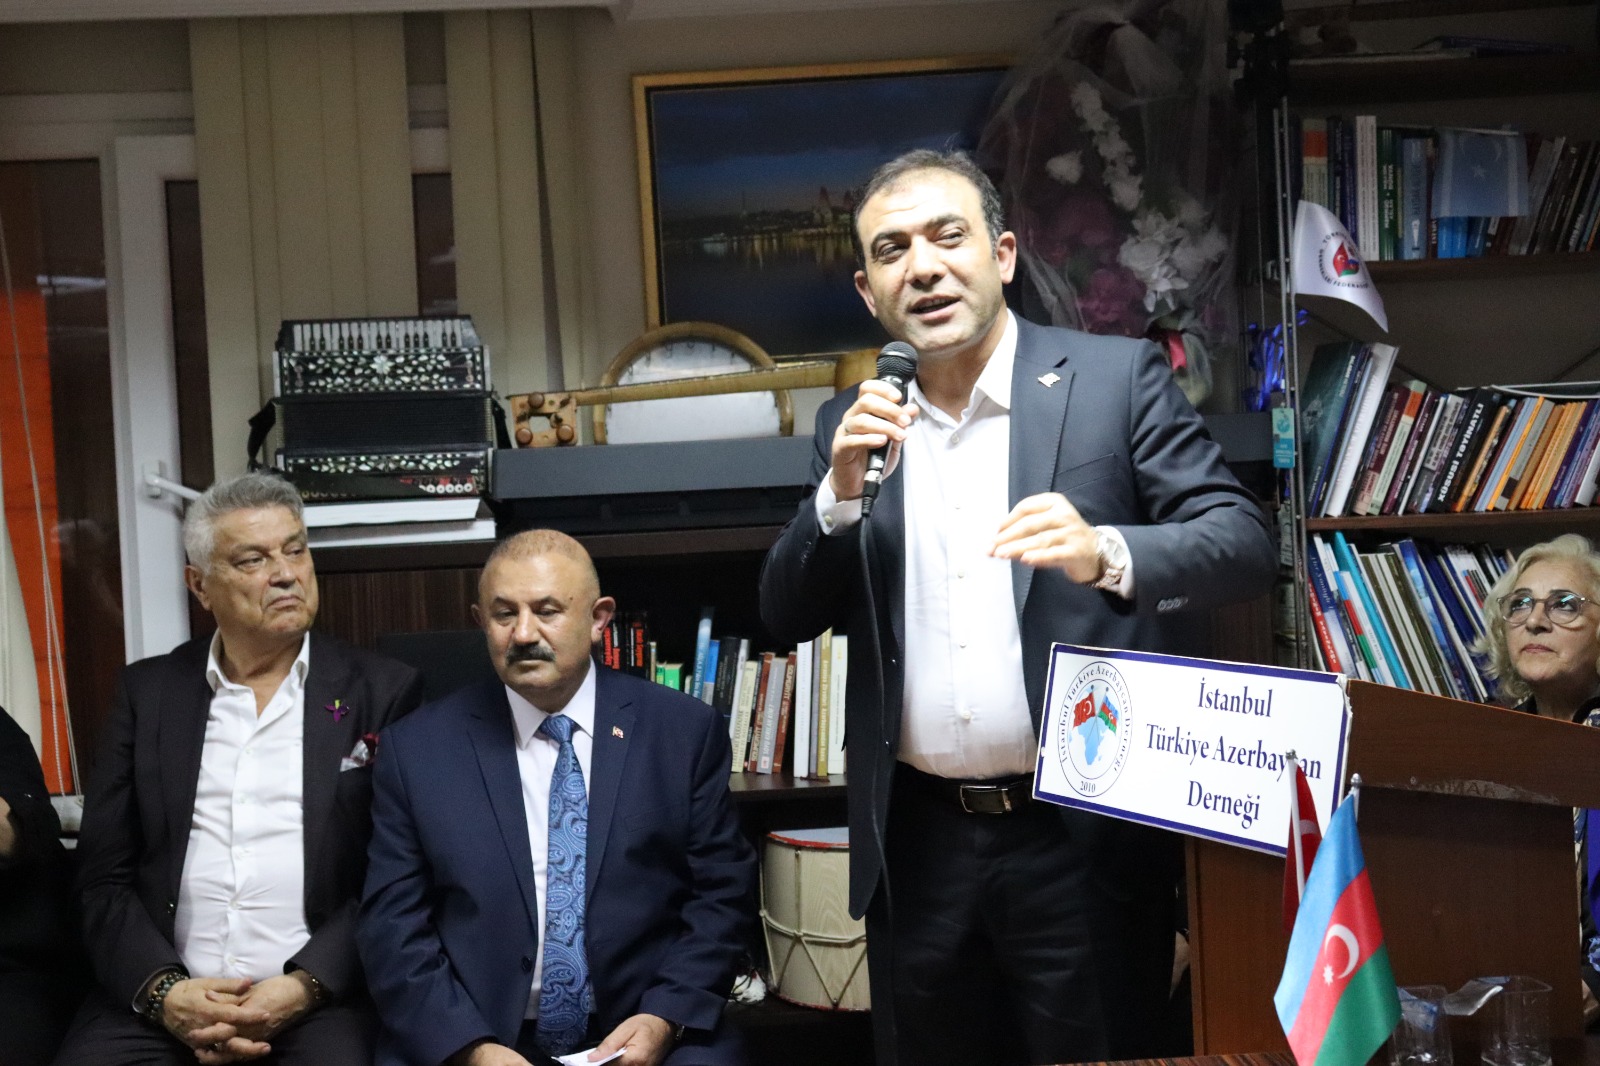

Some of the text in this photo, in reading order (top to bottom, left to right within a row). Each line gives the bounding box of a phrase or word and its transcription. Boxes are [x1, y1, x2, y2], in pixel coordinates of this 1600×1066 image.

[1197, 676, 1273, 717] İstanbul
[1146, 723, 1322, 782] Türkiye Azerbayan
[1080, 780, 1096, 793] 2010
[1186, 780, 1261, 829] Derneği
